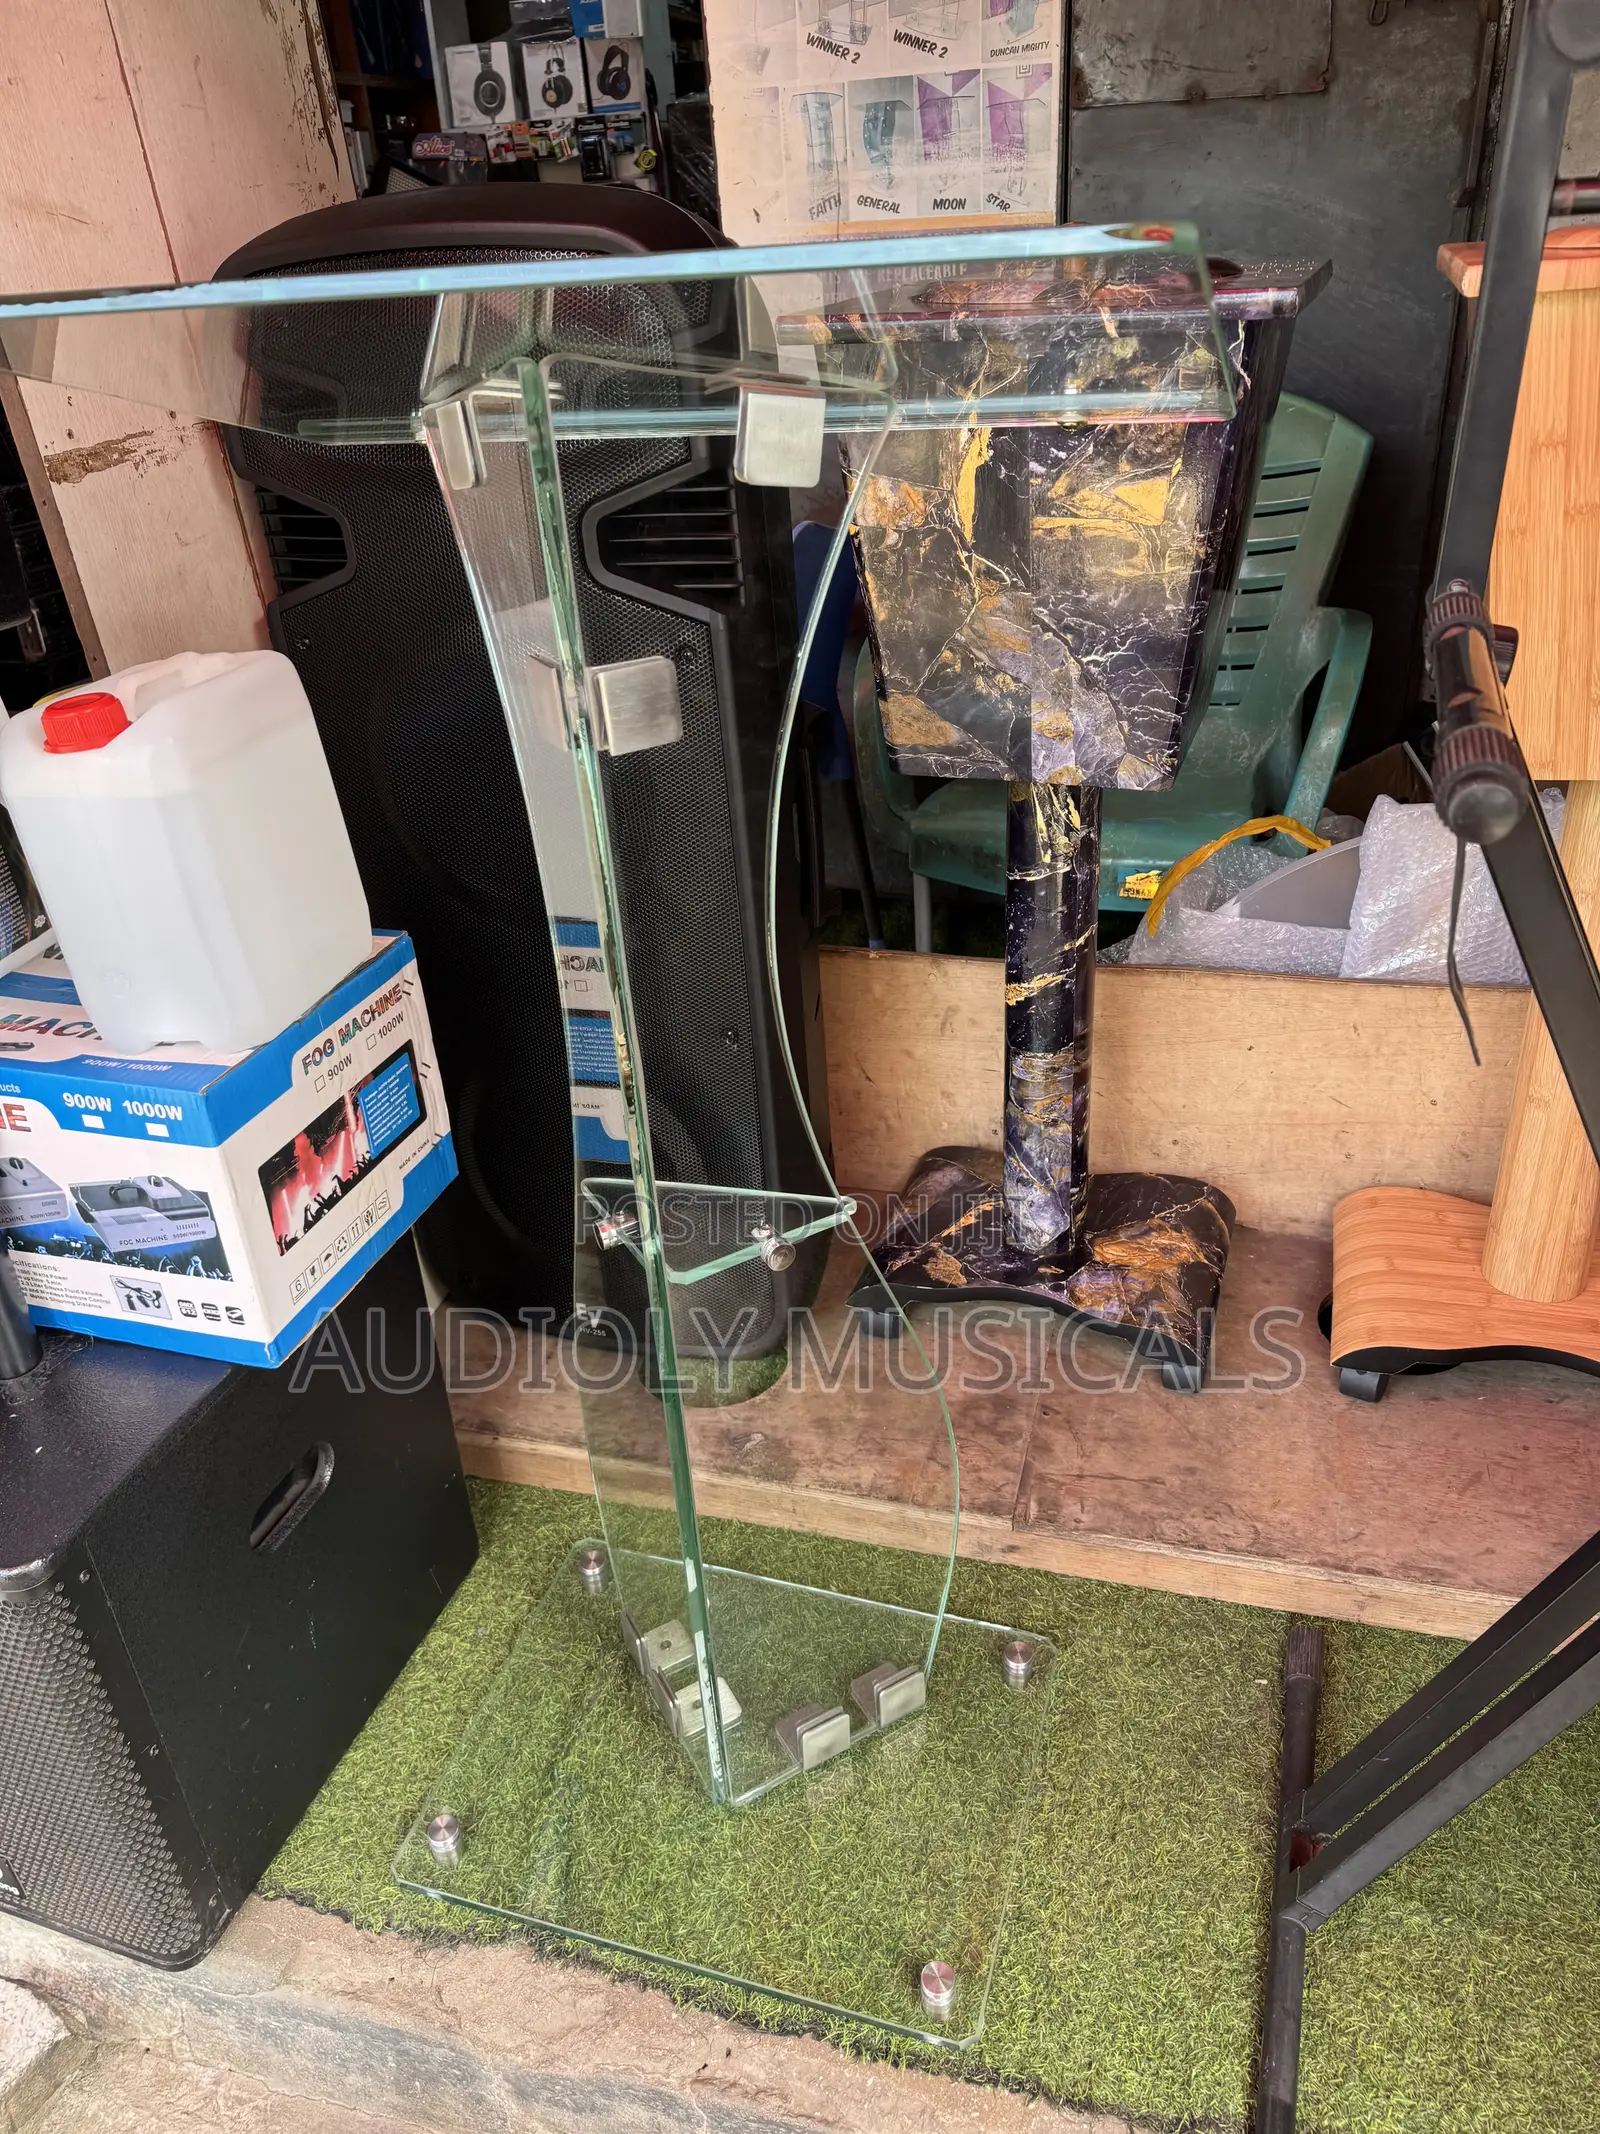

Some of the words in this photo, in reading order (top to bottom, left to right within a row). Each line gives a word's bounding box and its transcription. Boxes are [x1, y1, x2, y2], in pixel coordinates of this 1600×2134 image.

[806, 32, 850, 60] WINNER
[851, 52, 861, 64] 2
[893, 29, 937, 55] WINNER
[938, 46, 949, 59] 2
[990, 45, 1020, 58] DUNCAN
[1021, 41, 1050, 53] MIGHTY
[808, 192, 842, 220] FAITH
[857, 194, 901, 214] GENERAL
[932, 198, 966, 211] MOON
[986, 193, 1011, 212] STAR
[302, 1038, 335, 1076] FOG
[337, 983, 402, 1047] MACHINE
[377, 1011, 404, 1039] 1000W
[327, 1053, 352, 1081] 900W
[0, 1082, 21, 1094] ucts
[62, 1092, 112, 1113] 900W
[122, 1099, 183, 1121] 1000W
[0, 1214, 24, 1224] ACHINE
[135, 1234, 169, 1245] MACHINE
